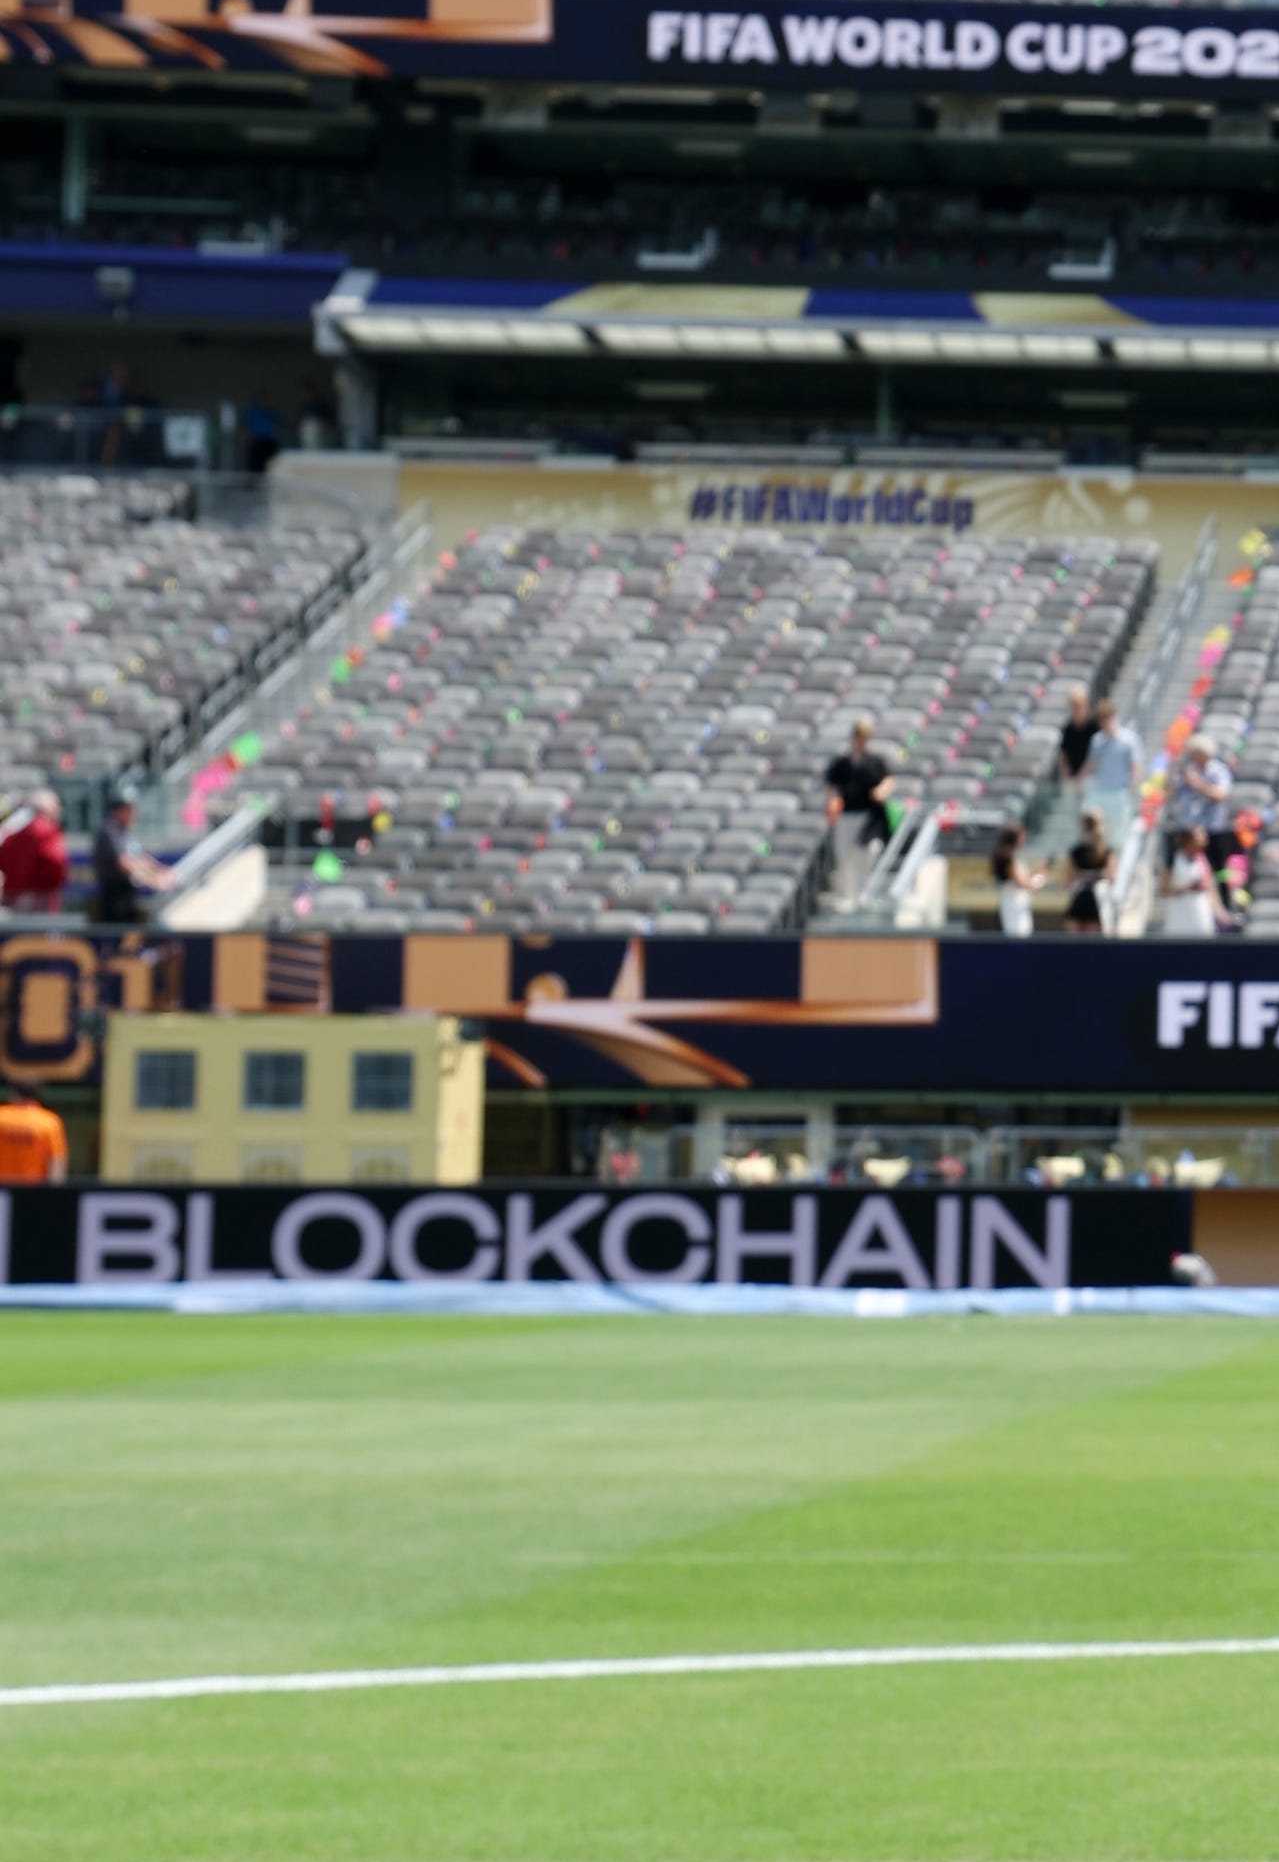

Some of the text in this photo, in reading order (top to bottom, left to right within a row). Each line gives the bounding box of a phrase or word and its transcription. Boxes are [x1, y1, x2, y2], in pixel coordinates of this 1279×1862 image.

[647, 11, 777, 64] FIFA
[782, 17, 999, 71] WORLD
[1006, 22, 1127, 76] CUP
[689, 484, 975, 532] #FIFAWorldCup
[76, 1191, 1071, 1287] BLOCKCHAIN
